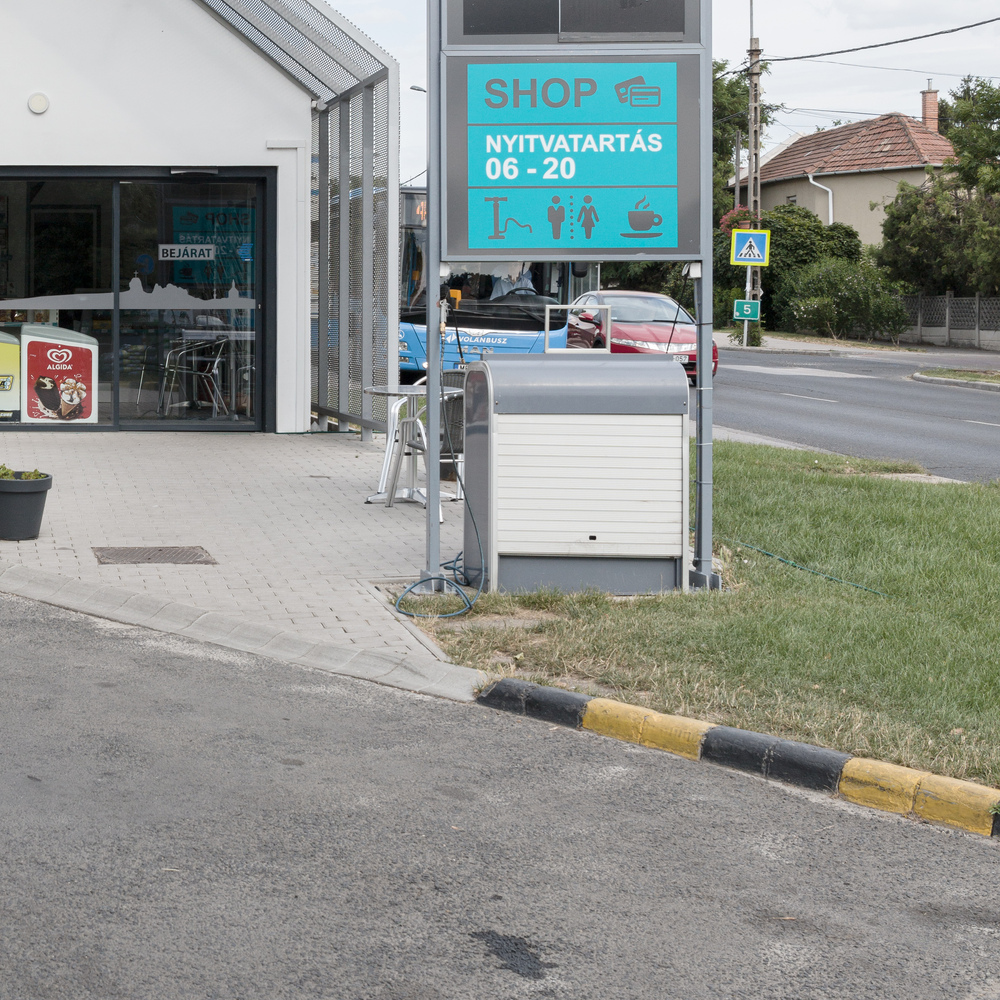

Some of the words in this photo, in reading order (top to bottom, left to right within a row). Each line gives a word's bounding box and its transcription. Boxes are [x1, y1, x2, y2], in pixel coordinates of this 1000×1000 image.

[484, 77, 598, 109] SHOP
[485, 129, 663, 153] NYITVATARTÁS
[485, 157, 519, 180] 06
[542, 157, 576, 180] 20
[161, 246, 213, 258] BEJÁRAT
[743, 304, 751, 315] 5
[457, 345, 495, 354] MAN
